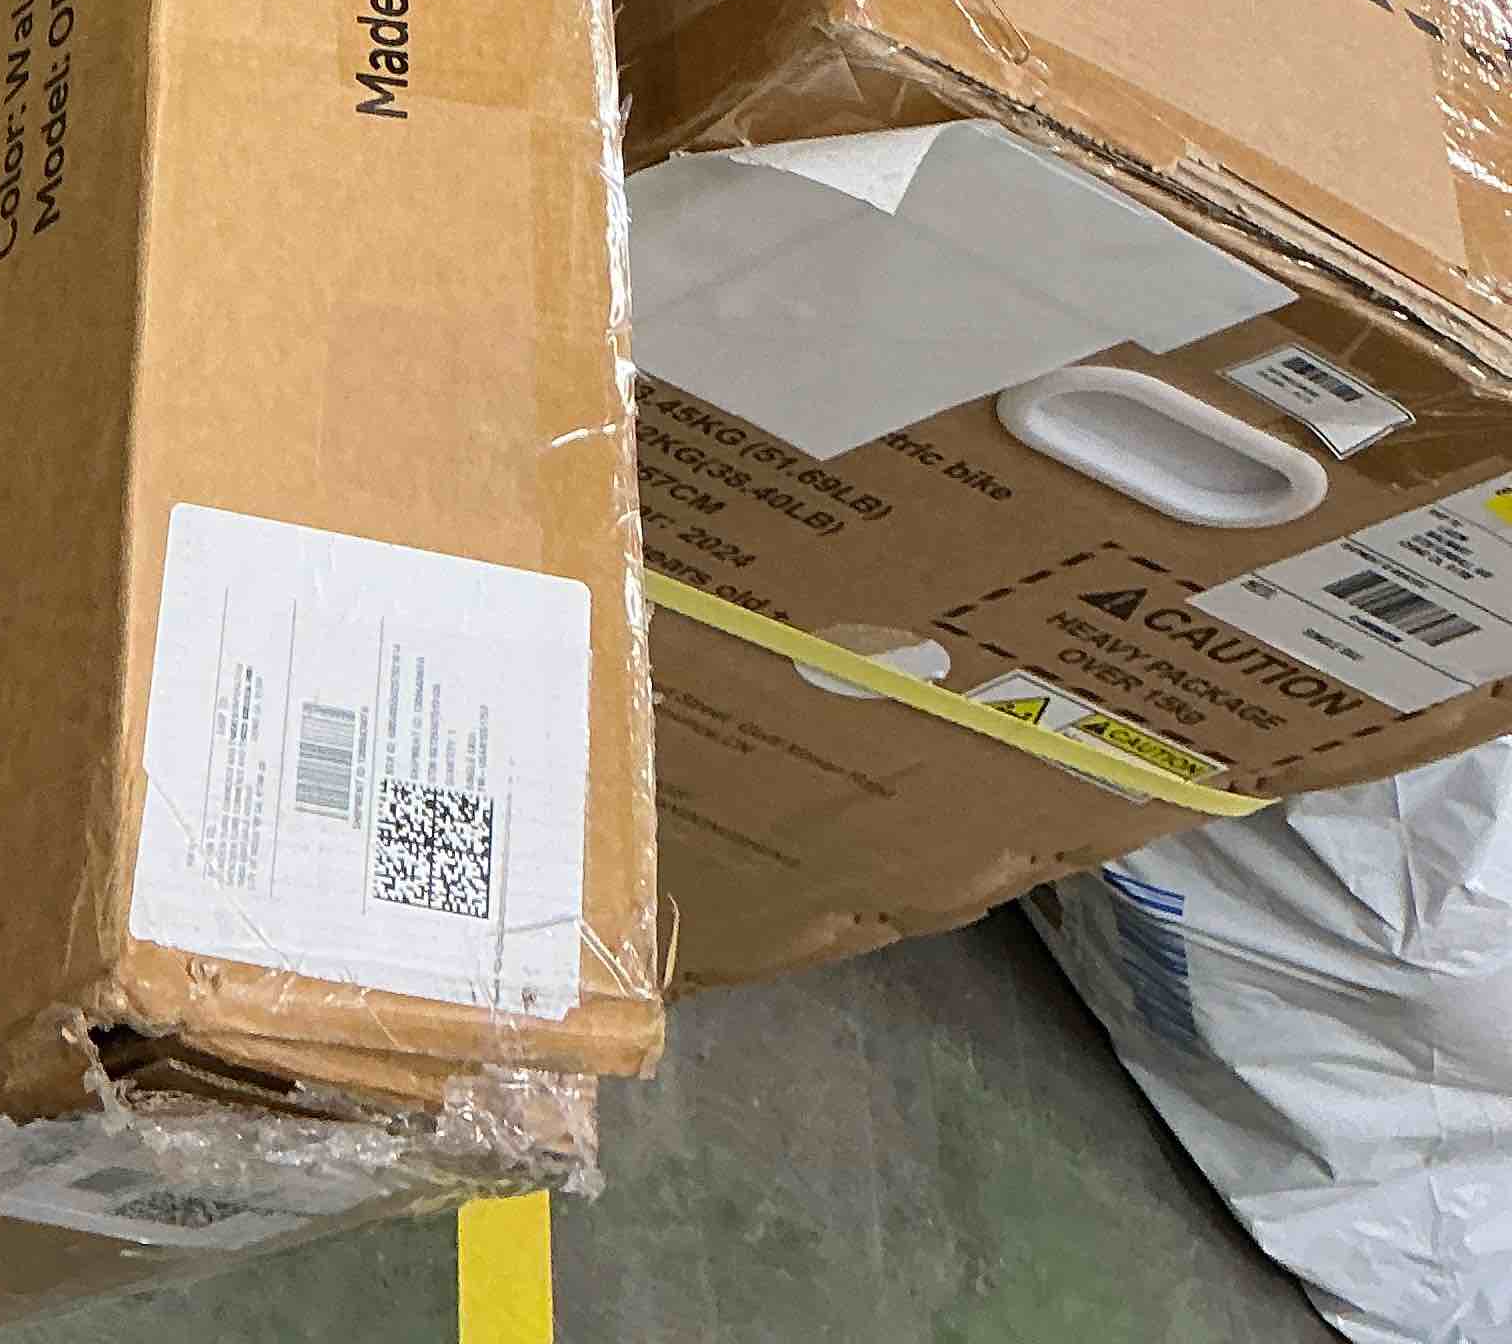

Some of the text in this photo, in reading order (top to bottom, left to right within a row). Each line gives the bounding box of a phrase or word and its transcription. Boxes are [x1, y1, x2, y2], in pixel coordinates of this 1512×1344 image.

[32, 52, 71, 236] Model:
[943, 461, 1014, 502] bike
[678, 525, 757, 570] 2024
[1046, 611, 1289, 731] HEAVY PACKAGE
[1057, 648, 1144, 691] OVER
[1143, 608, 1364, 718] CAUTION
